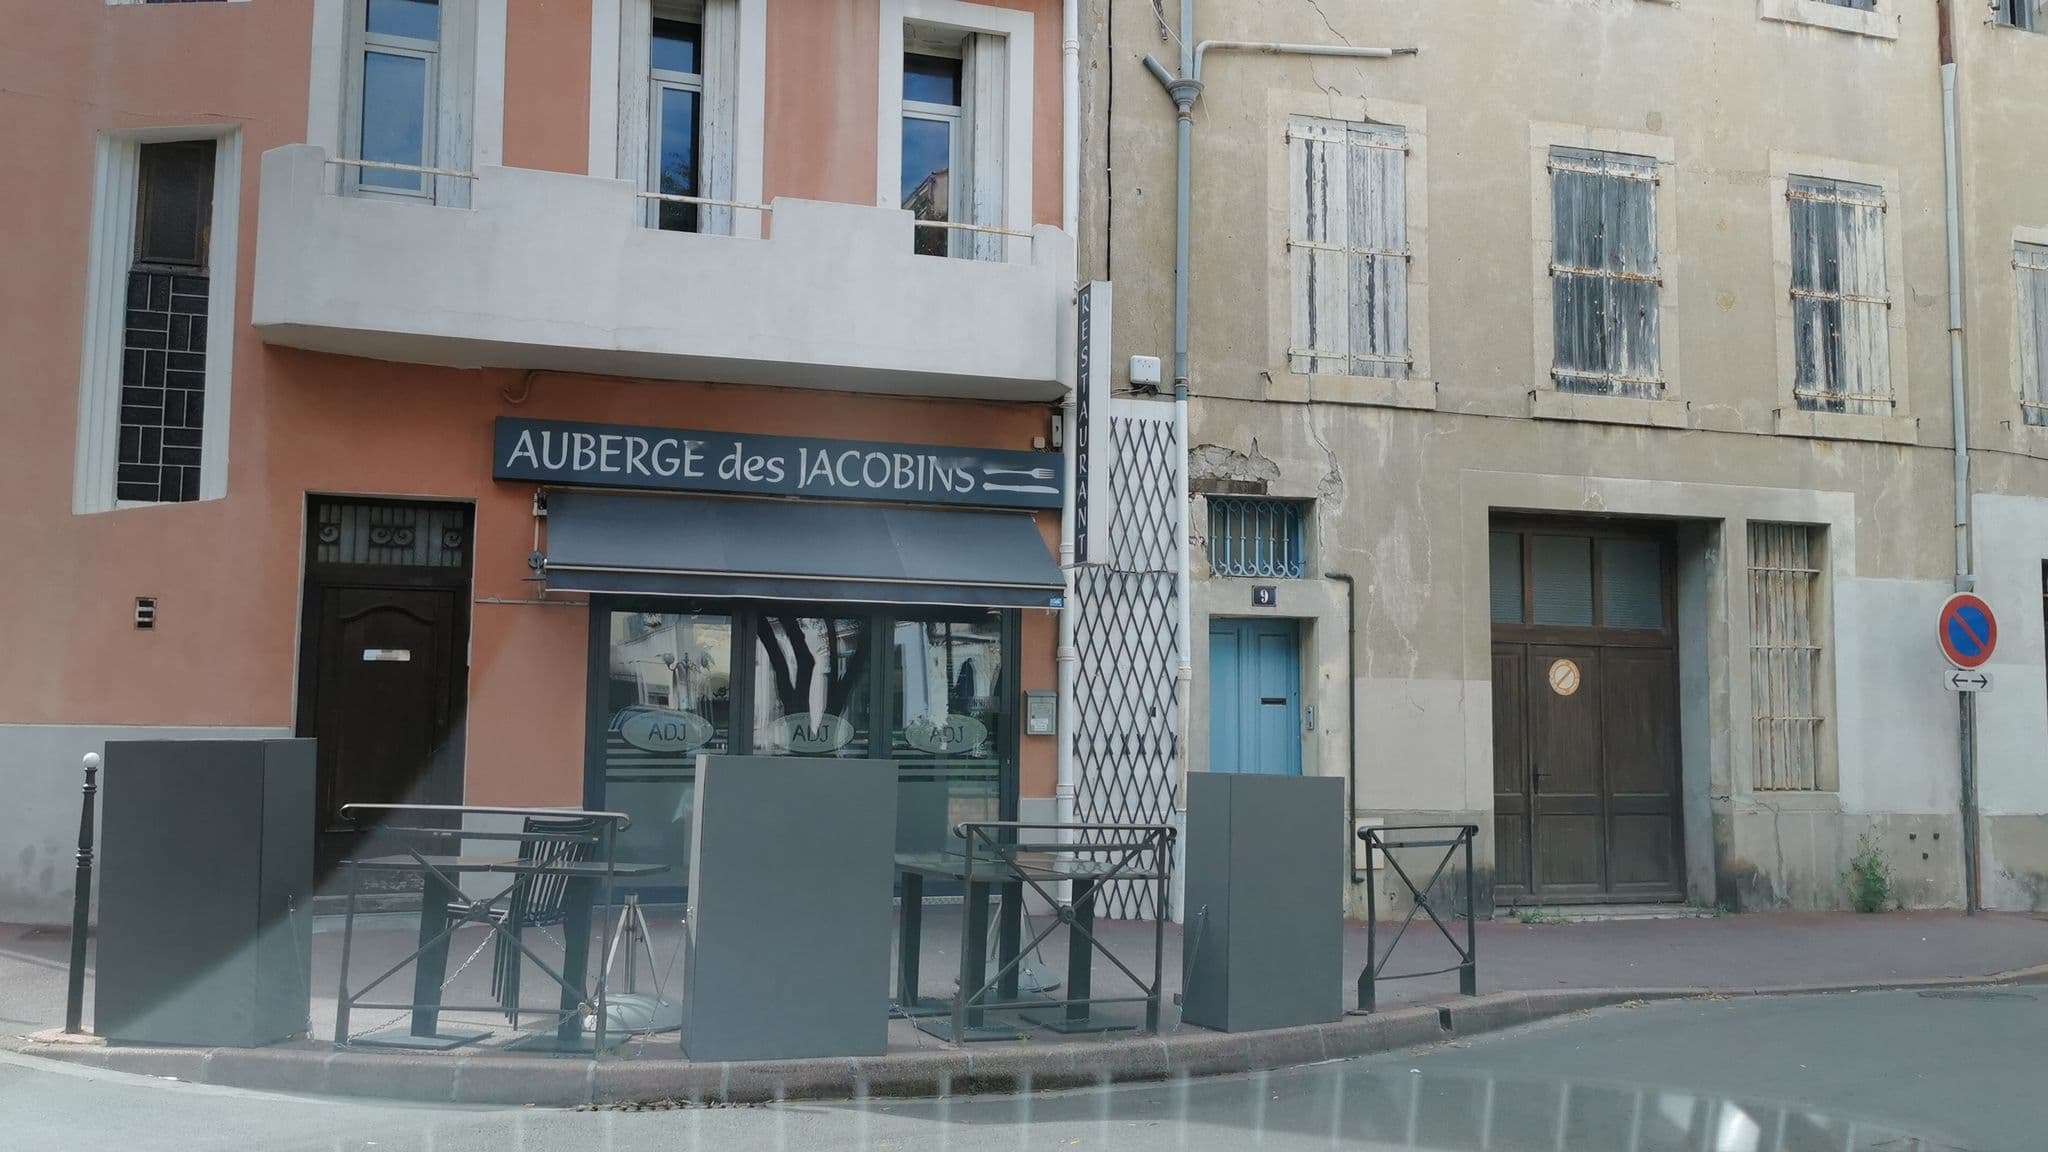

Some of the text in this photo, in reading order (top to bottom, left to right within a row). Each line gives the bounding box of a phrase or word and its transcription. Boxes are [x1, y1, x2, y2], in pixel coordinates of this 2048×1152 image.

[1077, 293, 1089, 555] RESTAURANT
[506, 429, 976, 493] AUBERGE des JACOBINS
[1260, 589, 1269, 604] 9
[648, 722, 687, 741] ADJ
[792, 723, 830, 742] ADJ
[929, 726, 965, 743] ADJ
